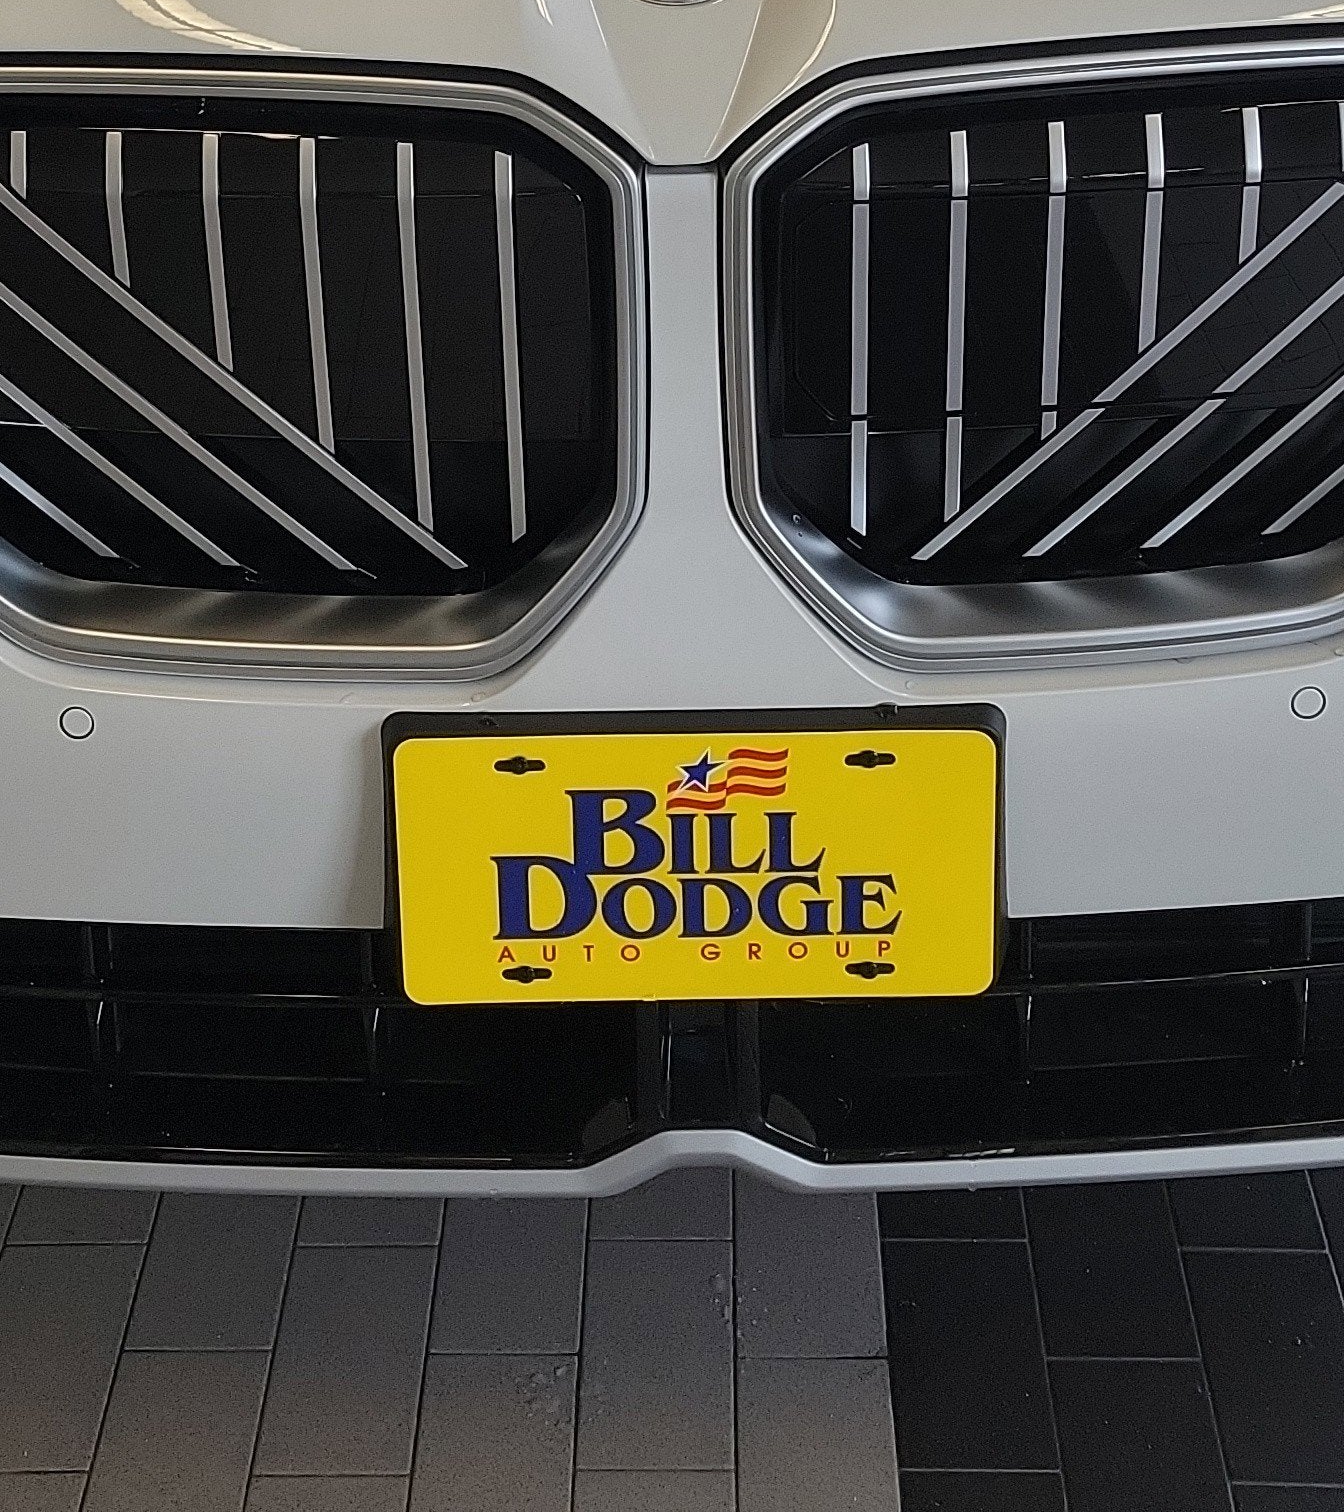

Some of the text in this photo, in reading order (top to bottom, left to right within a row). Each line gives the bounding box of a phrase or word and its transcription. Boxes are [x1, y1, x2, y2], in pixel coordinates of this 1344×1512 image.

[564, 789, 826, 876] BILL
[490, 855, 903, 940] DODGE
[497, 940, 892, 963] AUTO GROUP
